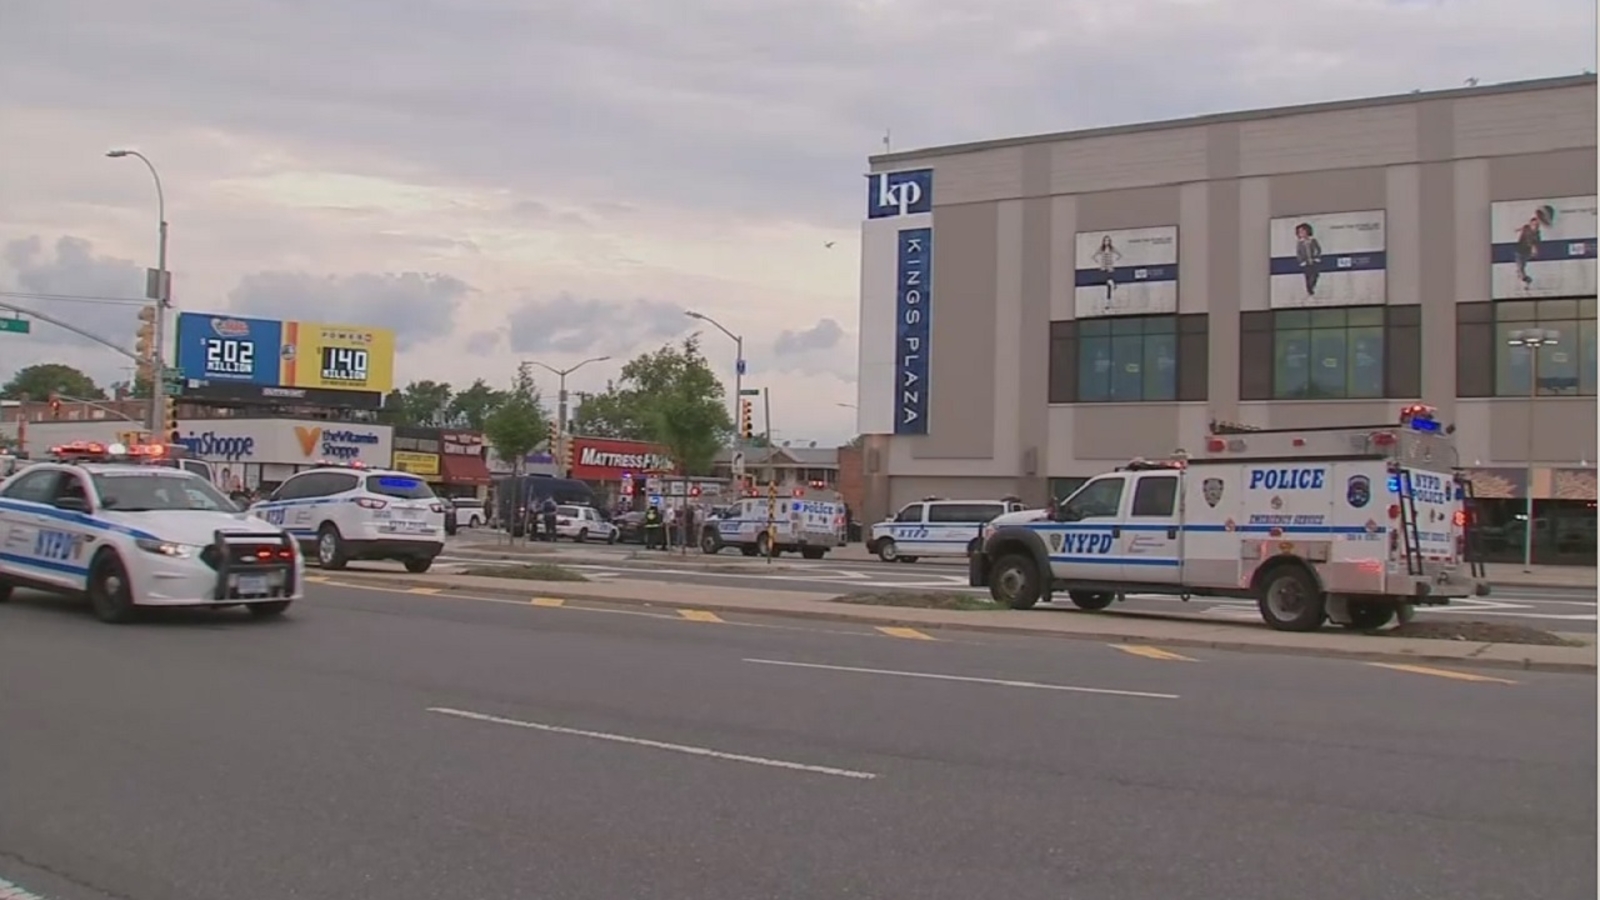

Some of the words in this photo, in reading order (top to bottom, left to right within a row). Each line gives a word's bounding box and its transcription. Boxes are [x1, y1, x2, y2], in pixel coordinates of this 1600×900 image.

[878, 172, 921, 215] kp
[905, 238, 922, 325] KINGS
[206, 361, 253, 373] MILLION
[322, 368, 366, 380] MILLION
[902, 336, 919, 424] PLAZA
[321, 443, 359, 457] Shoppe
[1249, 469, 1325, 490] POLICE
[1415, 473, 1441, 490] NYPD
[1410, 488, 1444, 504] POLICE
[803, 503, 834, 515] POLICE
[899, 528, 929, 539] NYPD
[34, 529, 74, 560] NYPD
[1061, 532, 1112, 554] NYPD
